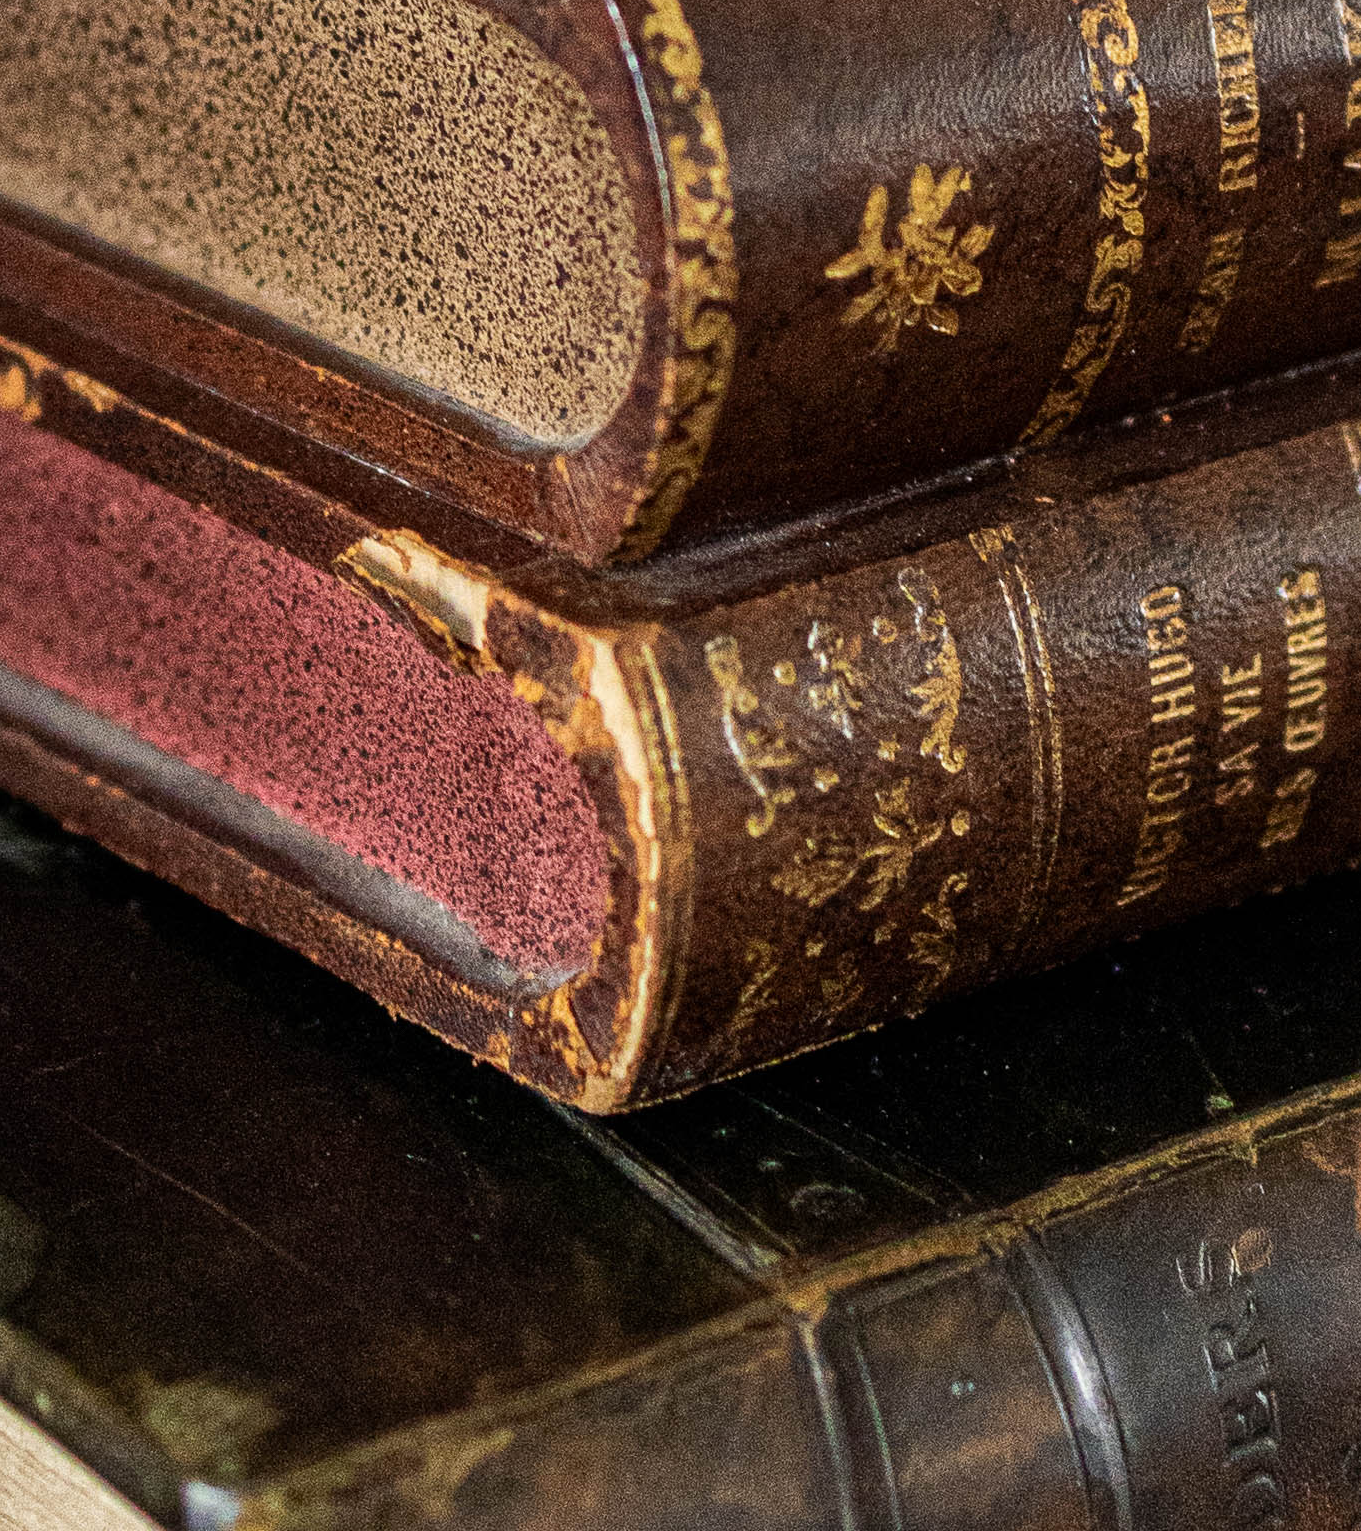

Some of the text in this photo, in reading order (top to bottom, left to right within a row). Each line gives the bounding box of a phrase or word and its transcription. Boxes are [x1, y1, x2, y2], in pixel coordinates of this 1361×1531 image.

[1116, 585, 1196, 908] VICTOR HUGO
[1214, 652, 1264, 807] SA VIE
